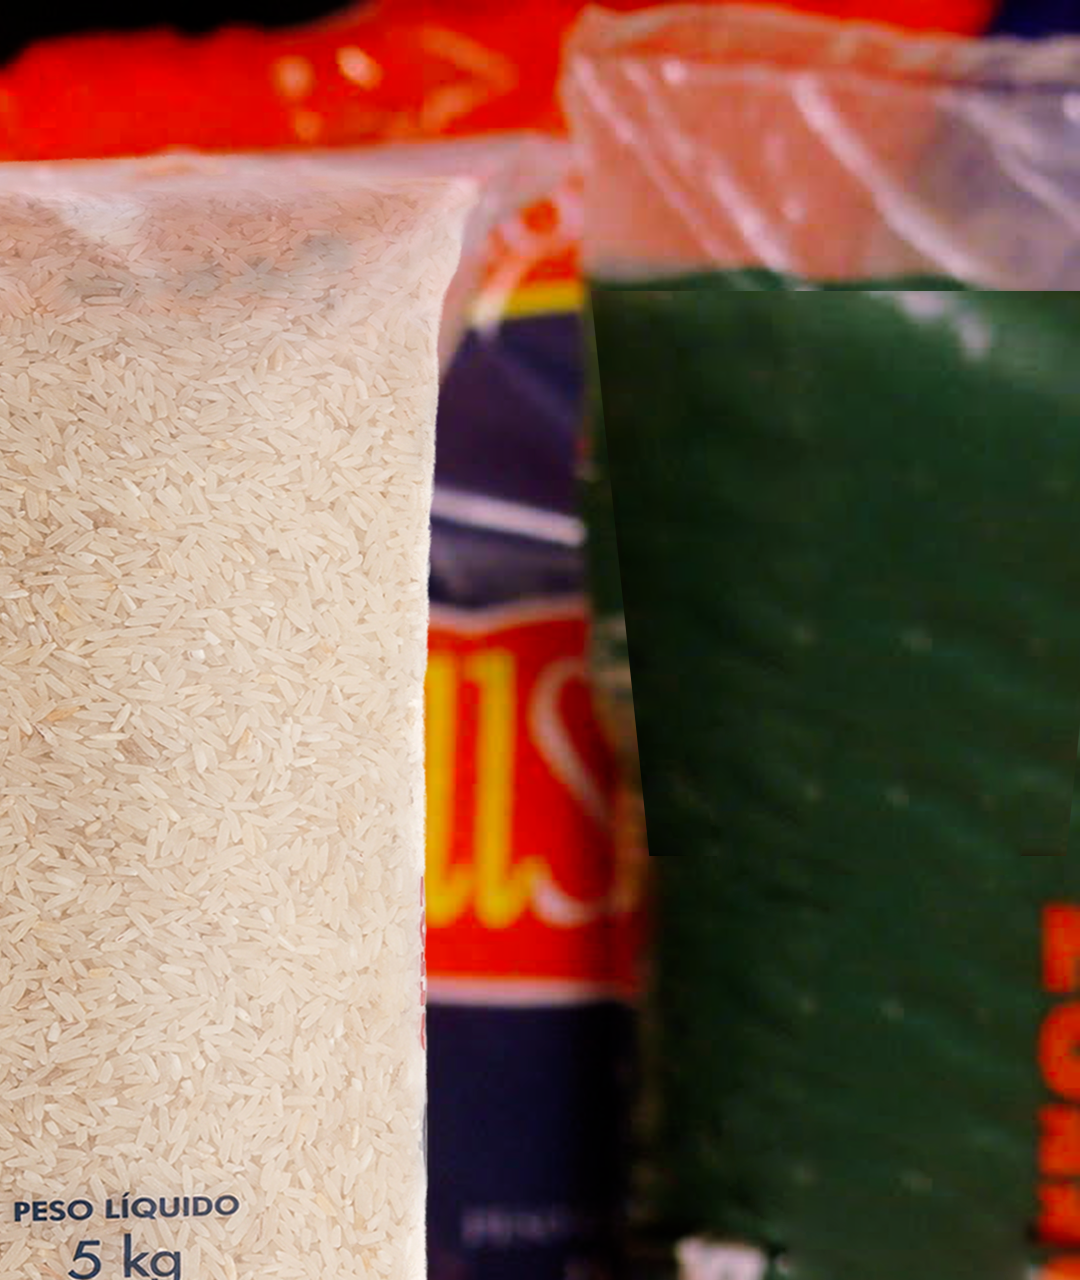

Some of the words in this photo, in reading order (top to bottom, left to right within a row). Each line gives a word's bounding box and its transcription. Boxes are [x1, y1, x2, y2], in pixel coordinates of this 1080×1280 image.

[13, 1199, 94, 1222] PESO
[105, 1192, 240, 1220] LÍQUIDO
[67, 1239, 103, 1280] 5
